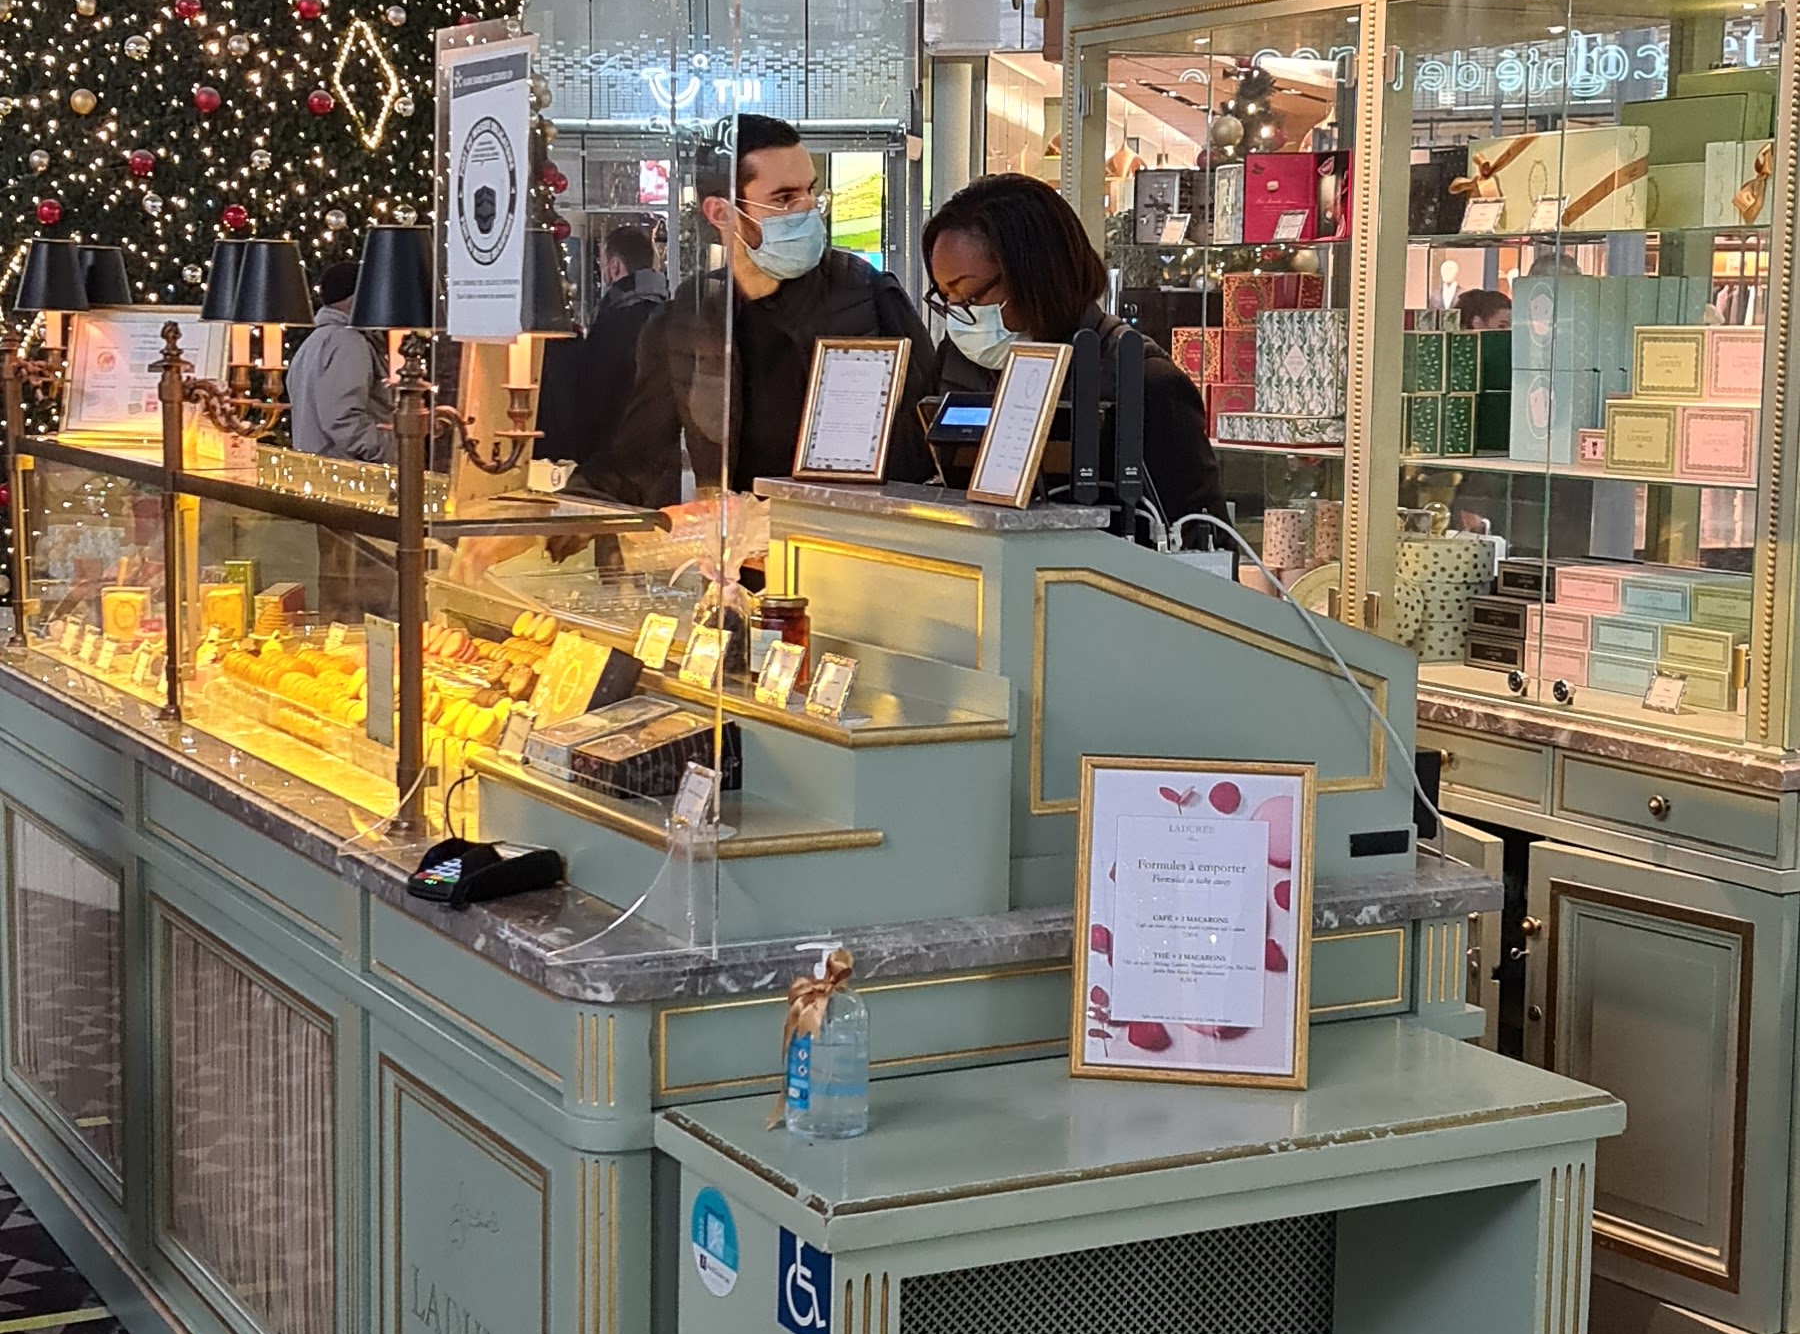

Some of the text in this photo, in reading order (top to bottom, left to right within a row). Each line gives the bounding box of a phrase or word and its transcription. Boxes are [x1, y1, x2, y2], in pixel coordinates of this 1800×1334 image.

[713, 78, 761, 104] TUI
[1138, 858, 1247, 875] Formules à emporter
[1153, 914, 1173, 922] CAFÉ
[1186, 915, 1229, 924] MACARONS
[1184, 953, 1227, 962] MACARONS
